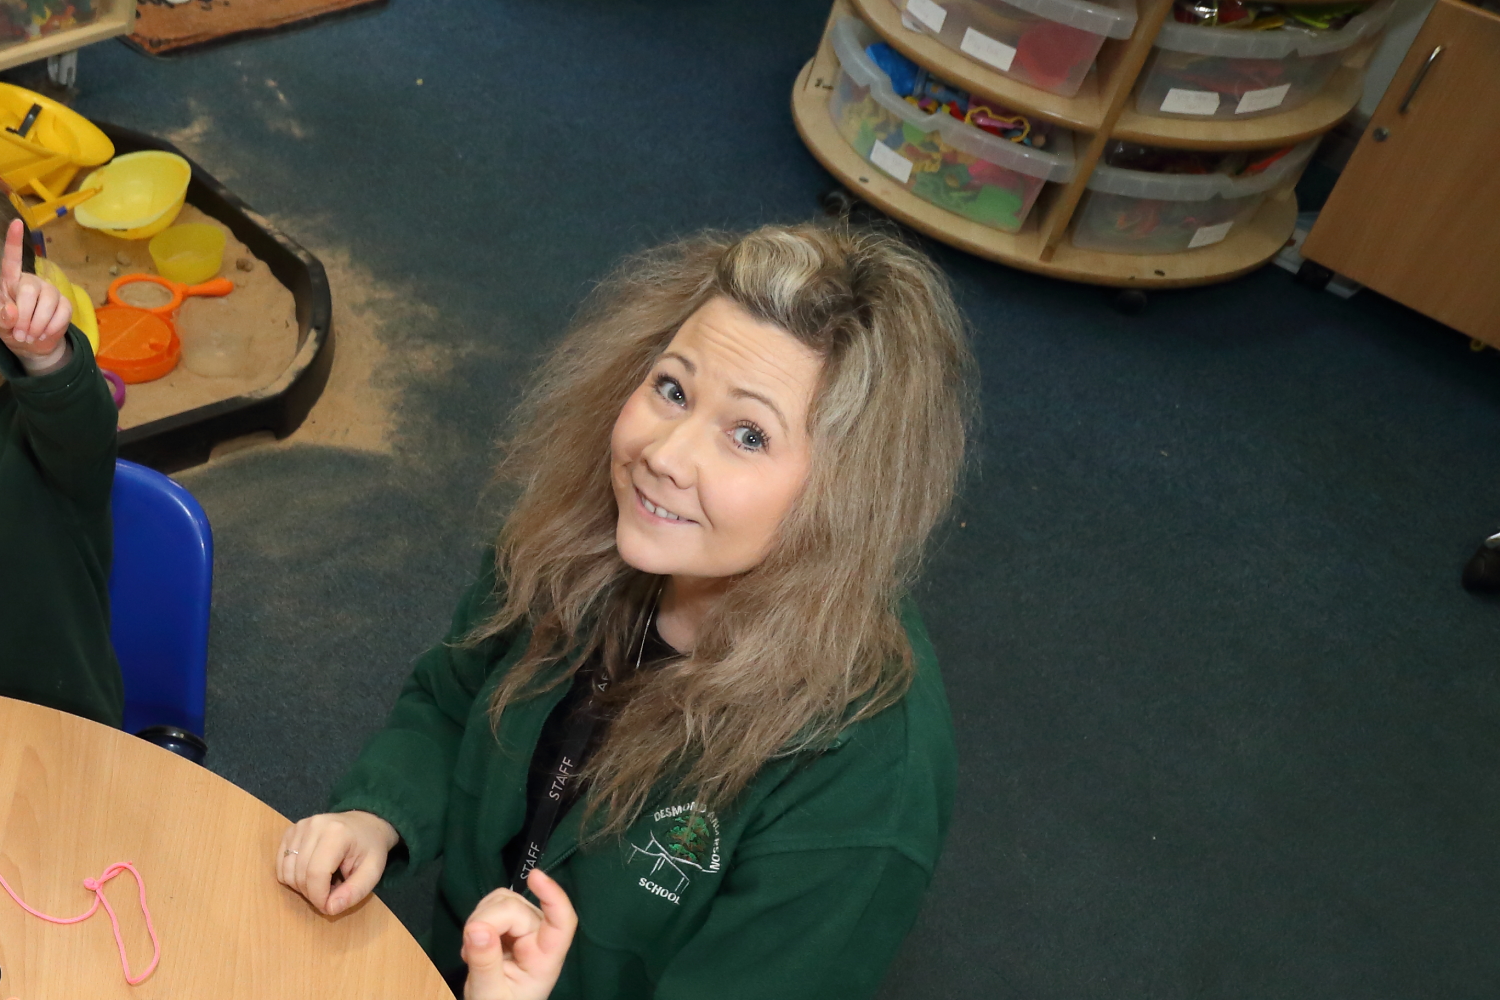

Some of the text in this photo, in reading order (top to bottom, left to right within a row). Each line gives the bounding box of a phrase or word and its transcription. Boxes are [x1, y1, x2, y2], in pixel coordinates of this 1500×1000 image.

[548, 756, 574, 801] STAFF
[653, 801, 707, 822] DESMOND
[520, 841, 541, 880] STAFF
[638, 877, 680, 905] SCHOOL
